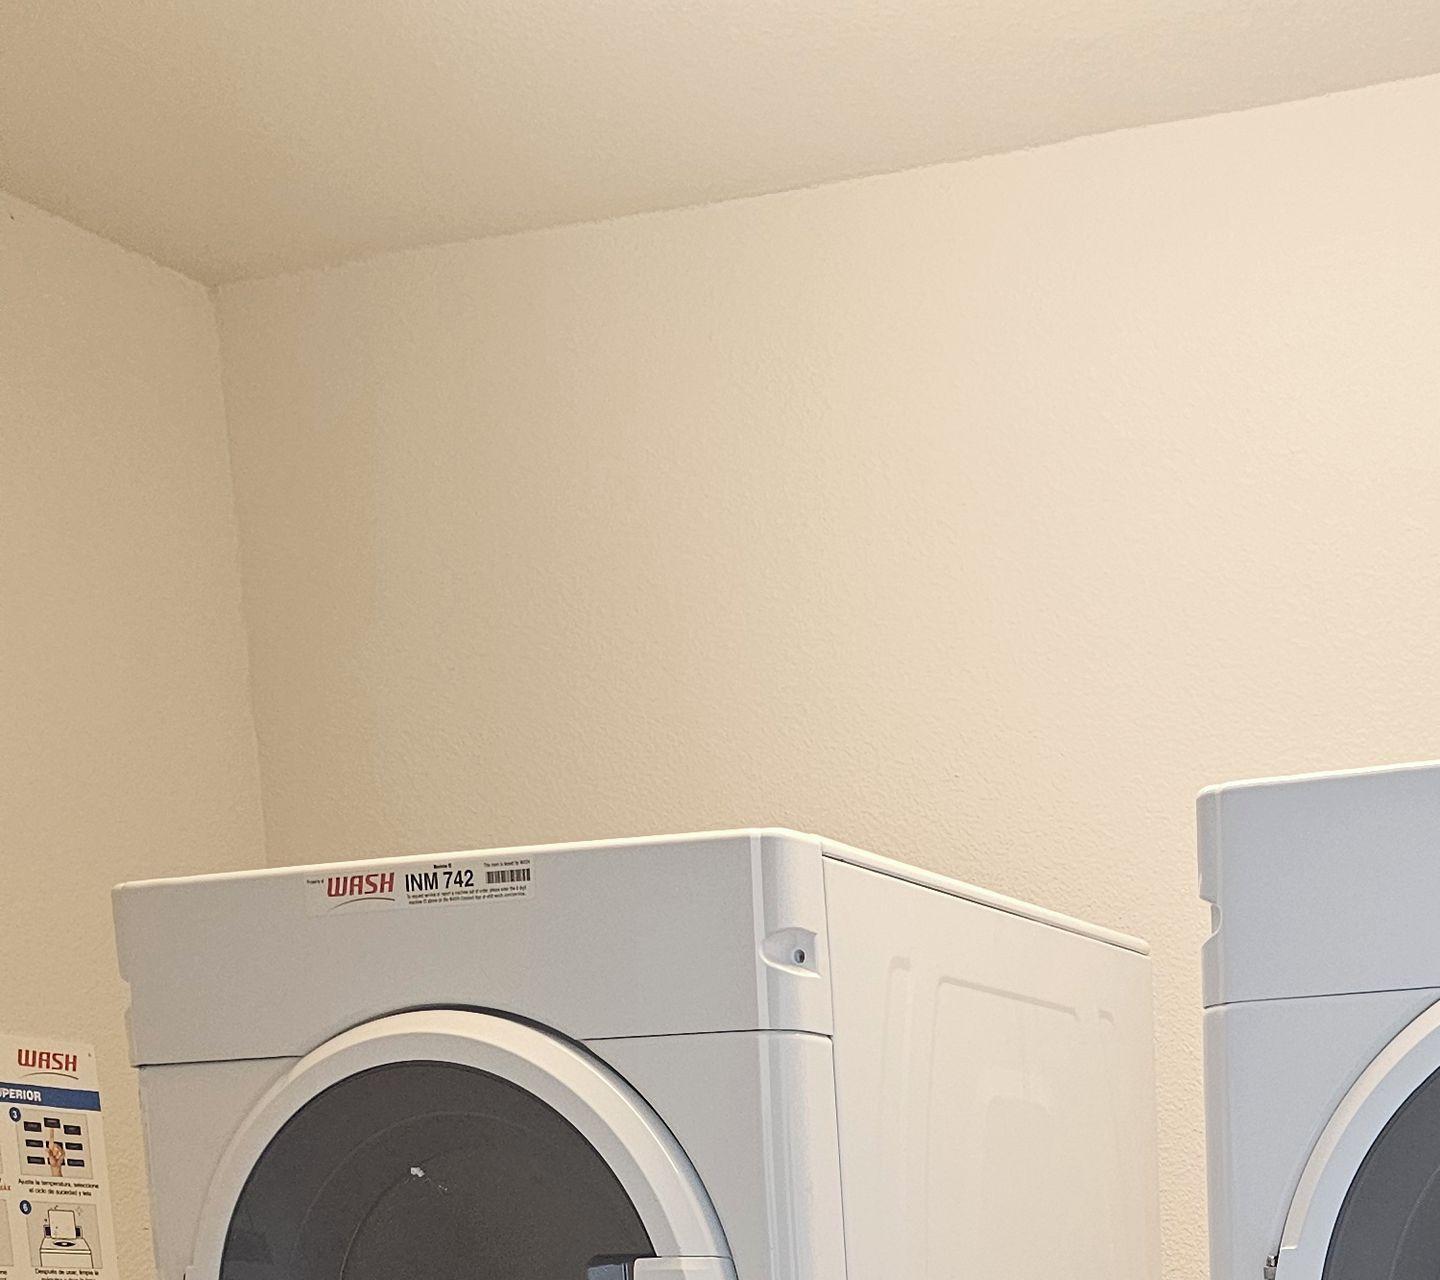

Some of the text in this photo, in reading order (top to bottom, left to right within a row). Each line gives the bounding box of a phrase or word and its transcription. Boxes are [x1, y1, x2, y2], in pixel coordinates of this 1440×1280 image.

[327, 872, 395, 897] WASH
[405, 872, 439, 892] INM
[443, 869, 474, 888] 742
[18, 1049, 77, 1071] WASH
